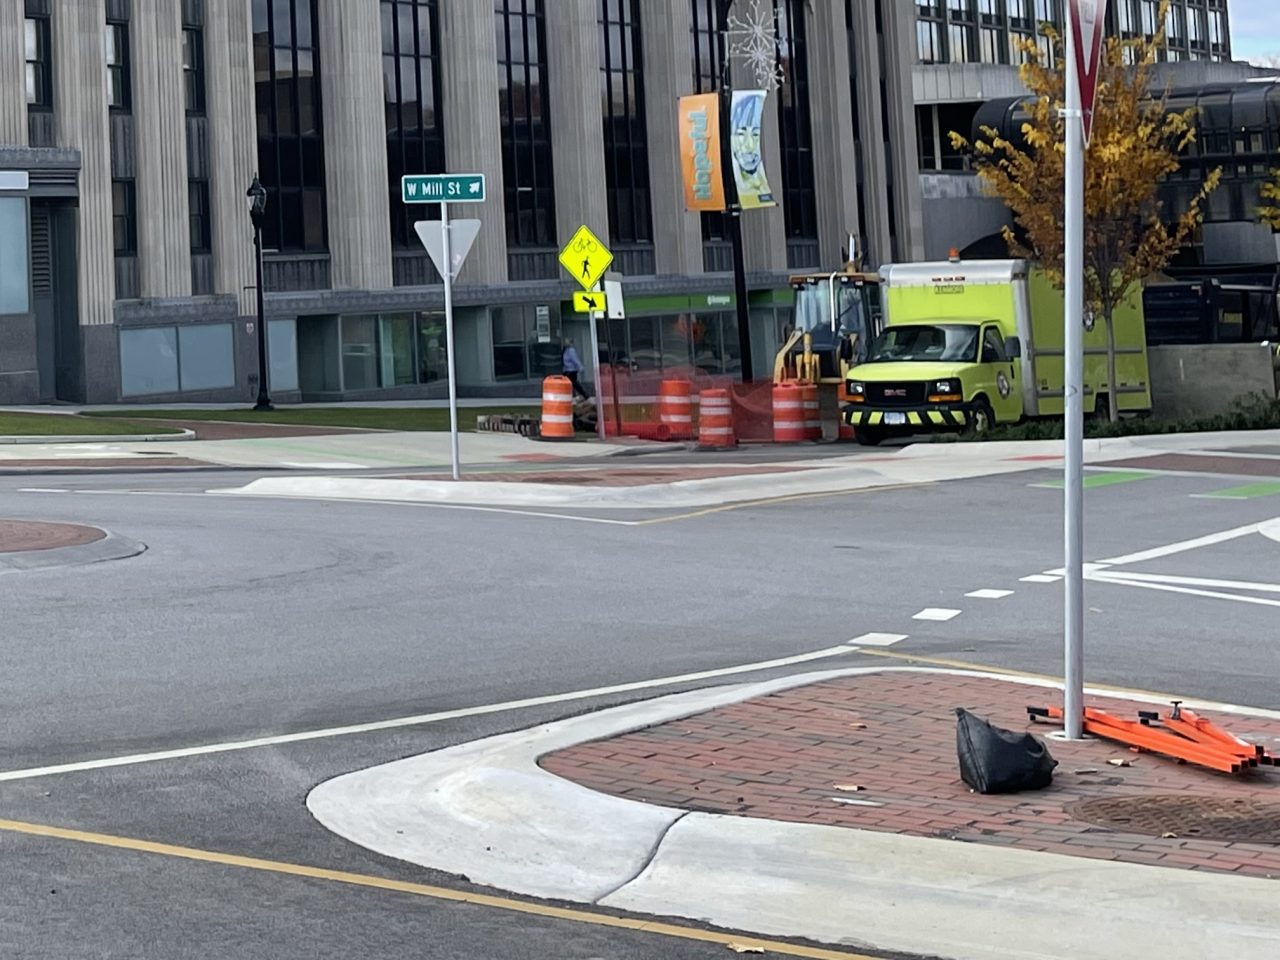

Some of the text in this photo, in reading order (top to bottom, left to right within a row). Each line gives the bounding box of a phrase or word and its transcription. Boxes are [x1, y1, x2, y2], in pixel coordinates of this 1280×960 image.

[406, 181, 461, 196] W Mill St
